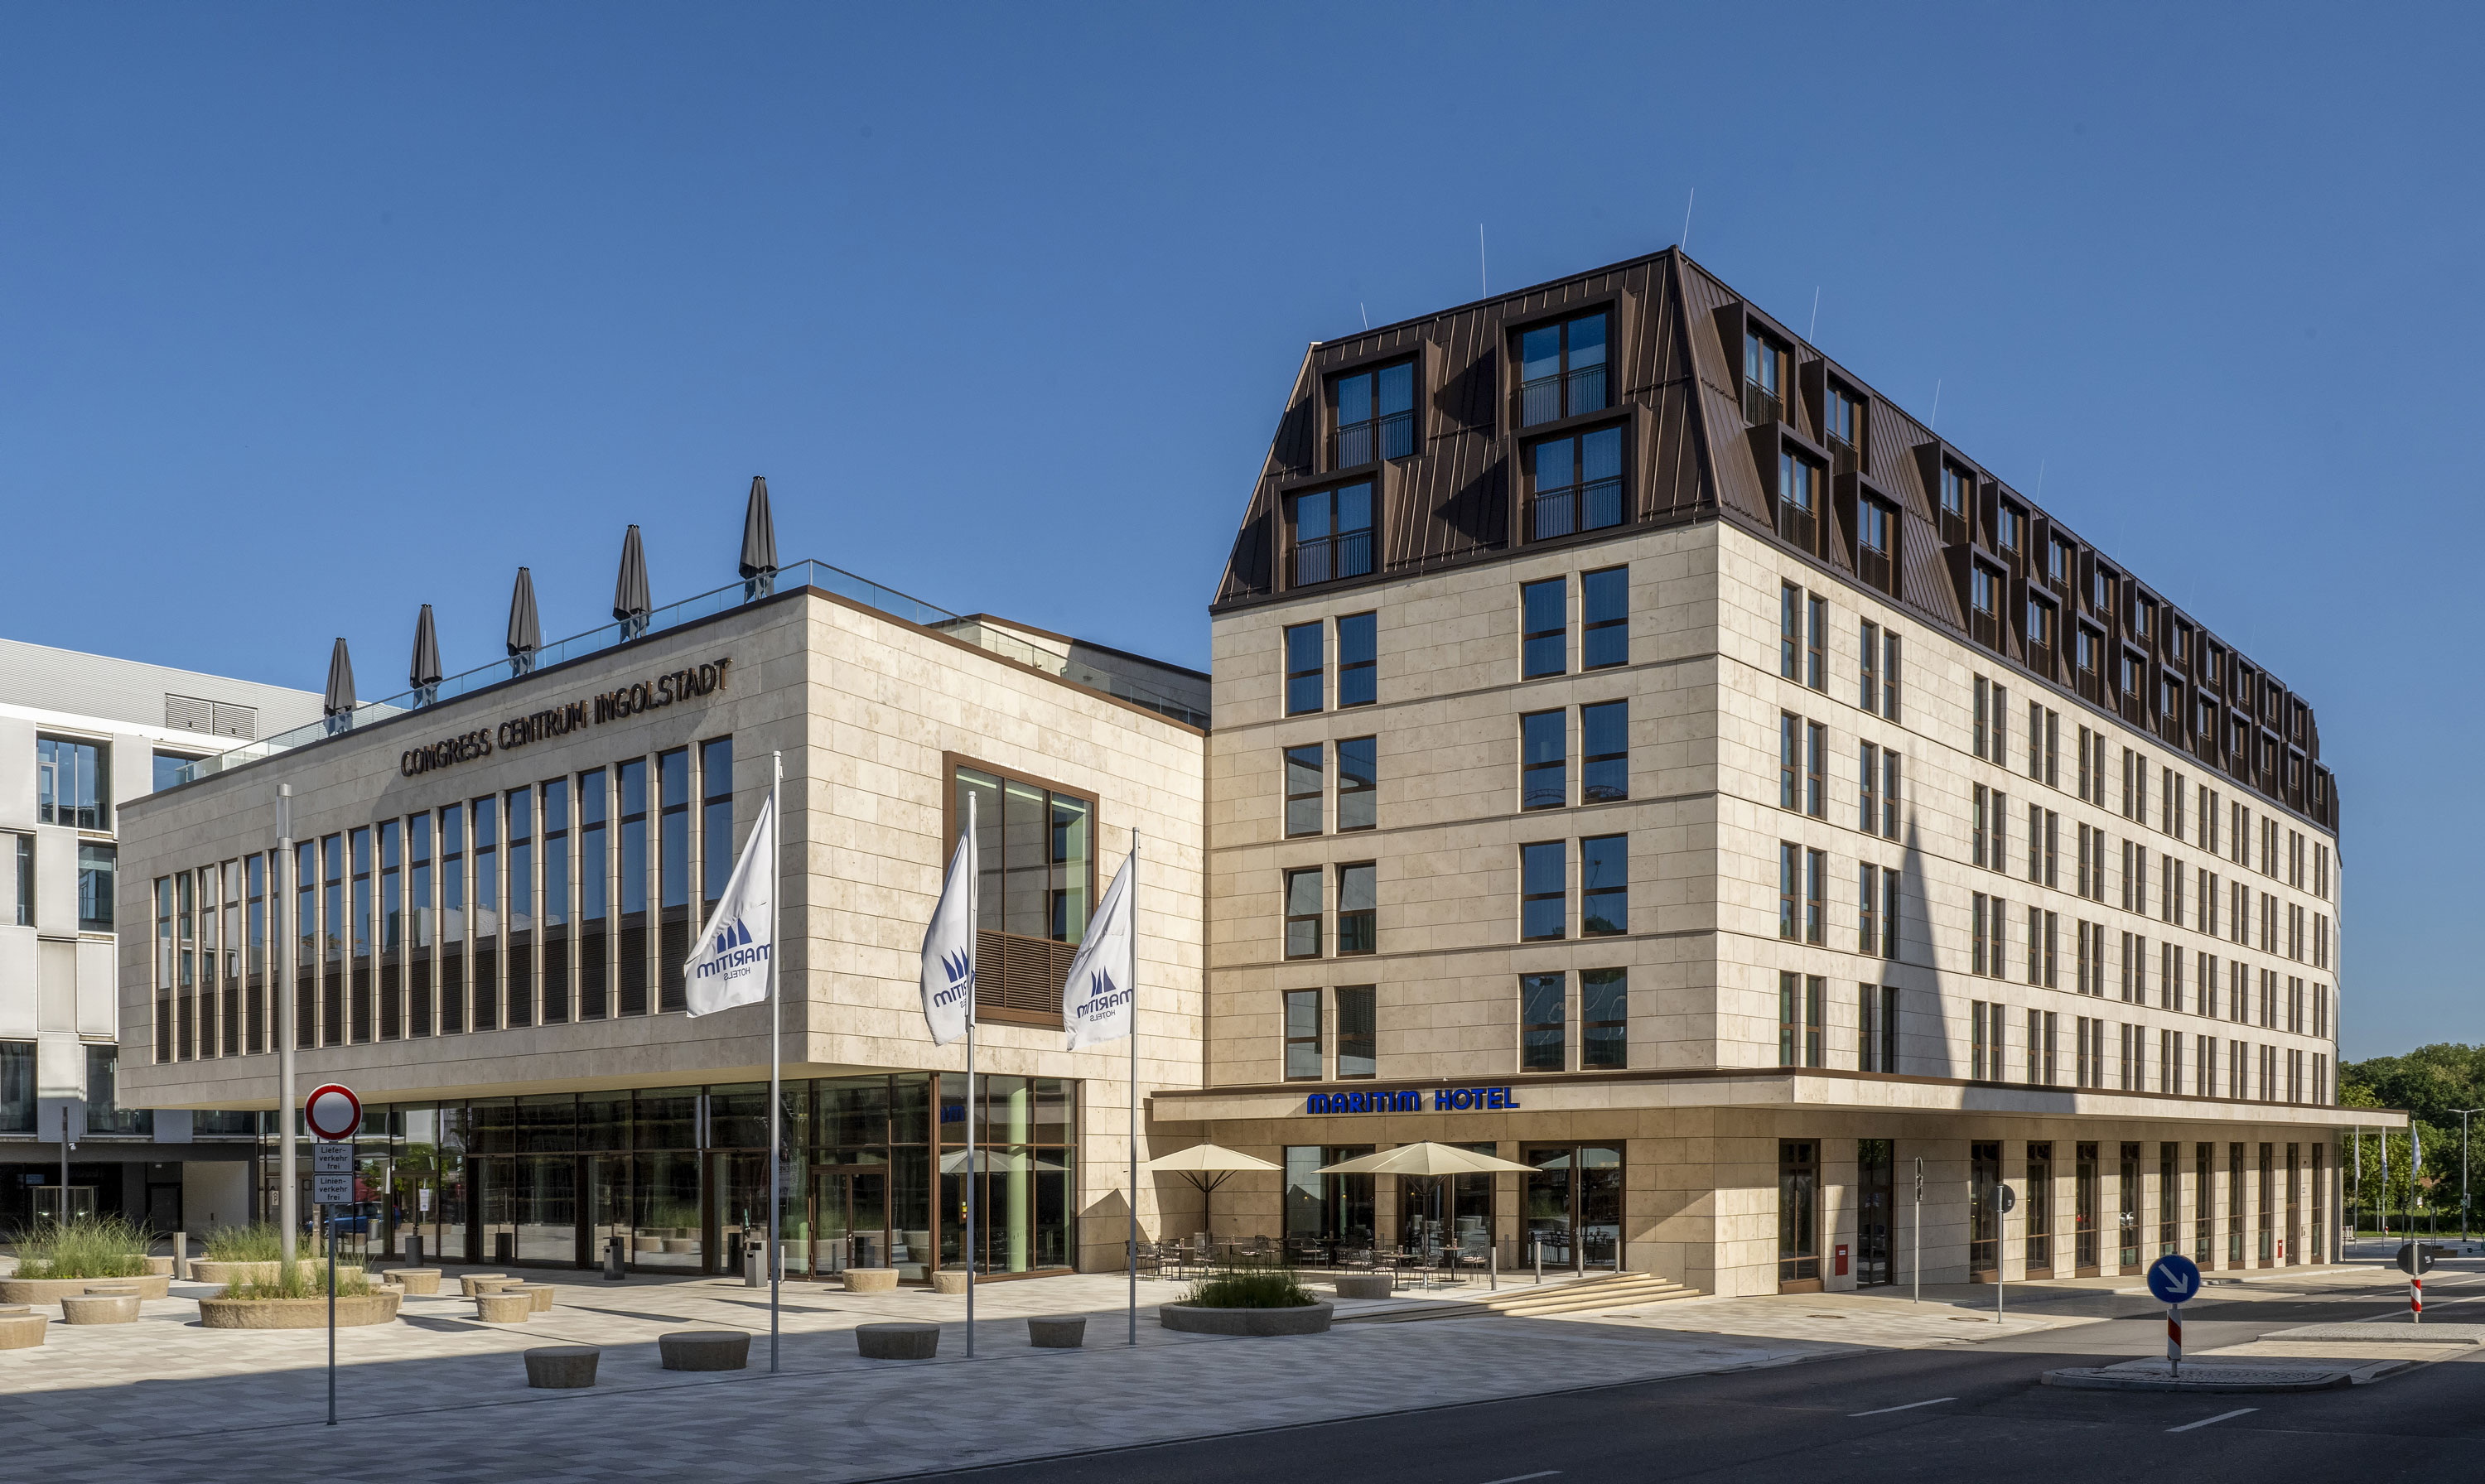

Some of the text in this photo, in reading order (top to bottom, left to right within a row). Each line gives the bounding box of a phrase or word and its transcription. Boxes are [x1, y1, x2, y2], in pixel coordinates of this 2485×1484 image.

[401, 657, 732, 777] CONGRESS CENTRUM INGOLSTADT
[1306, 1086, 1520, 1115] MARITIM HOTEL
